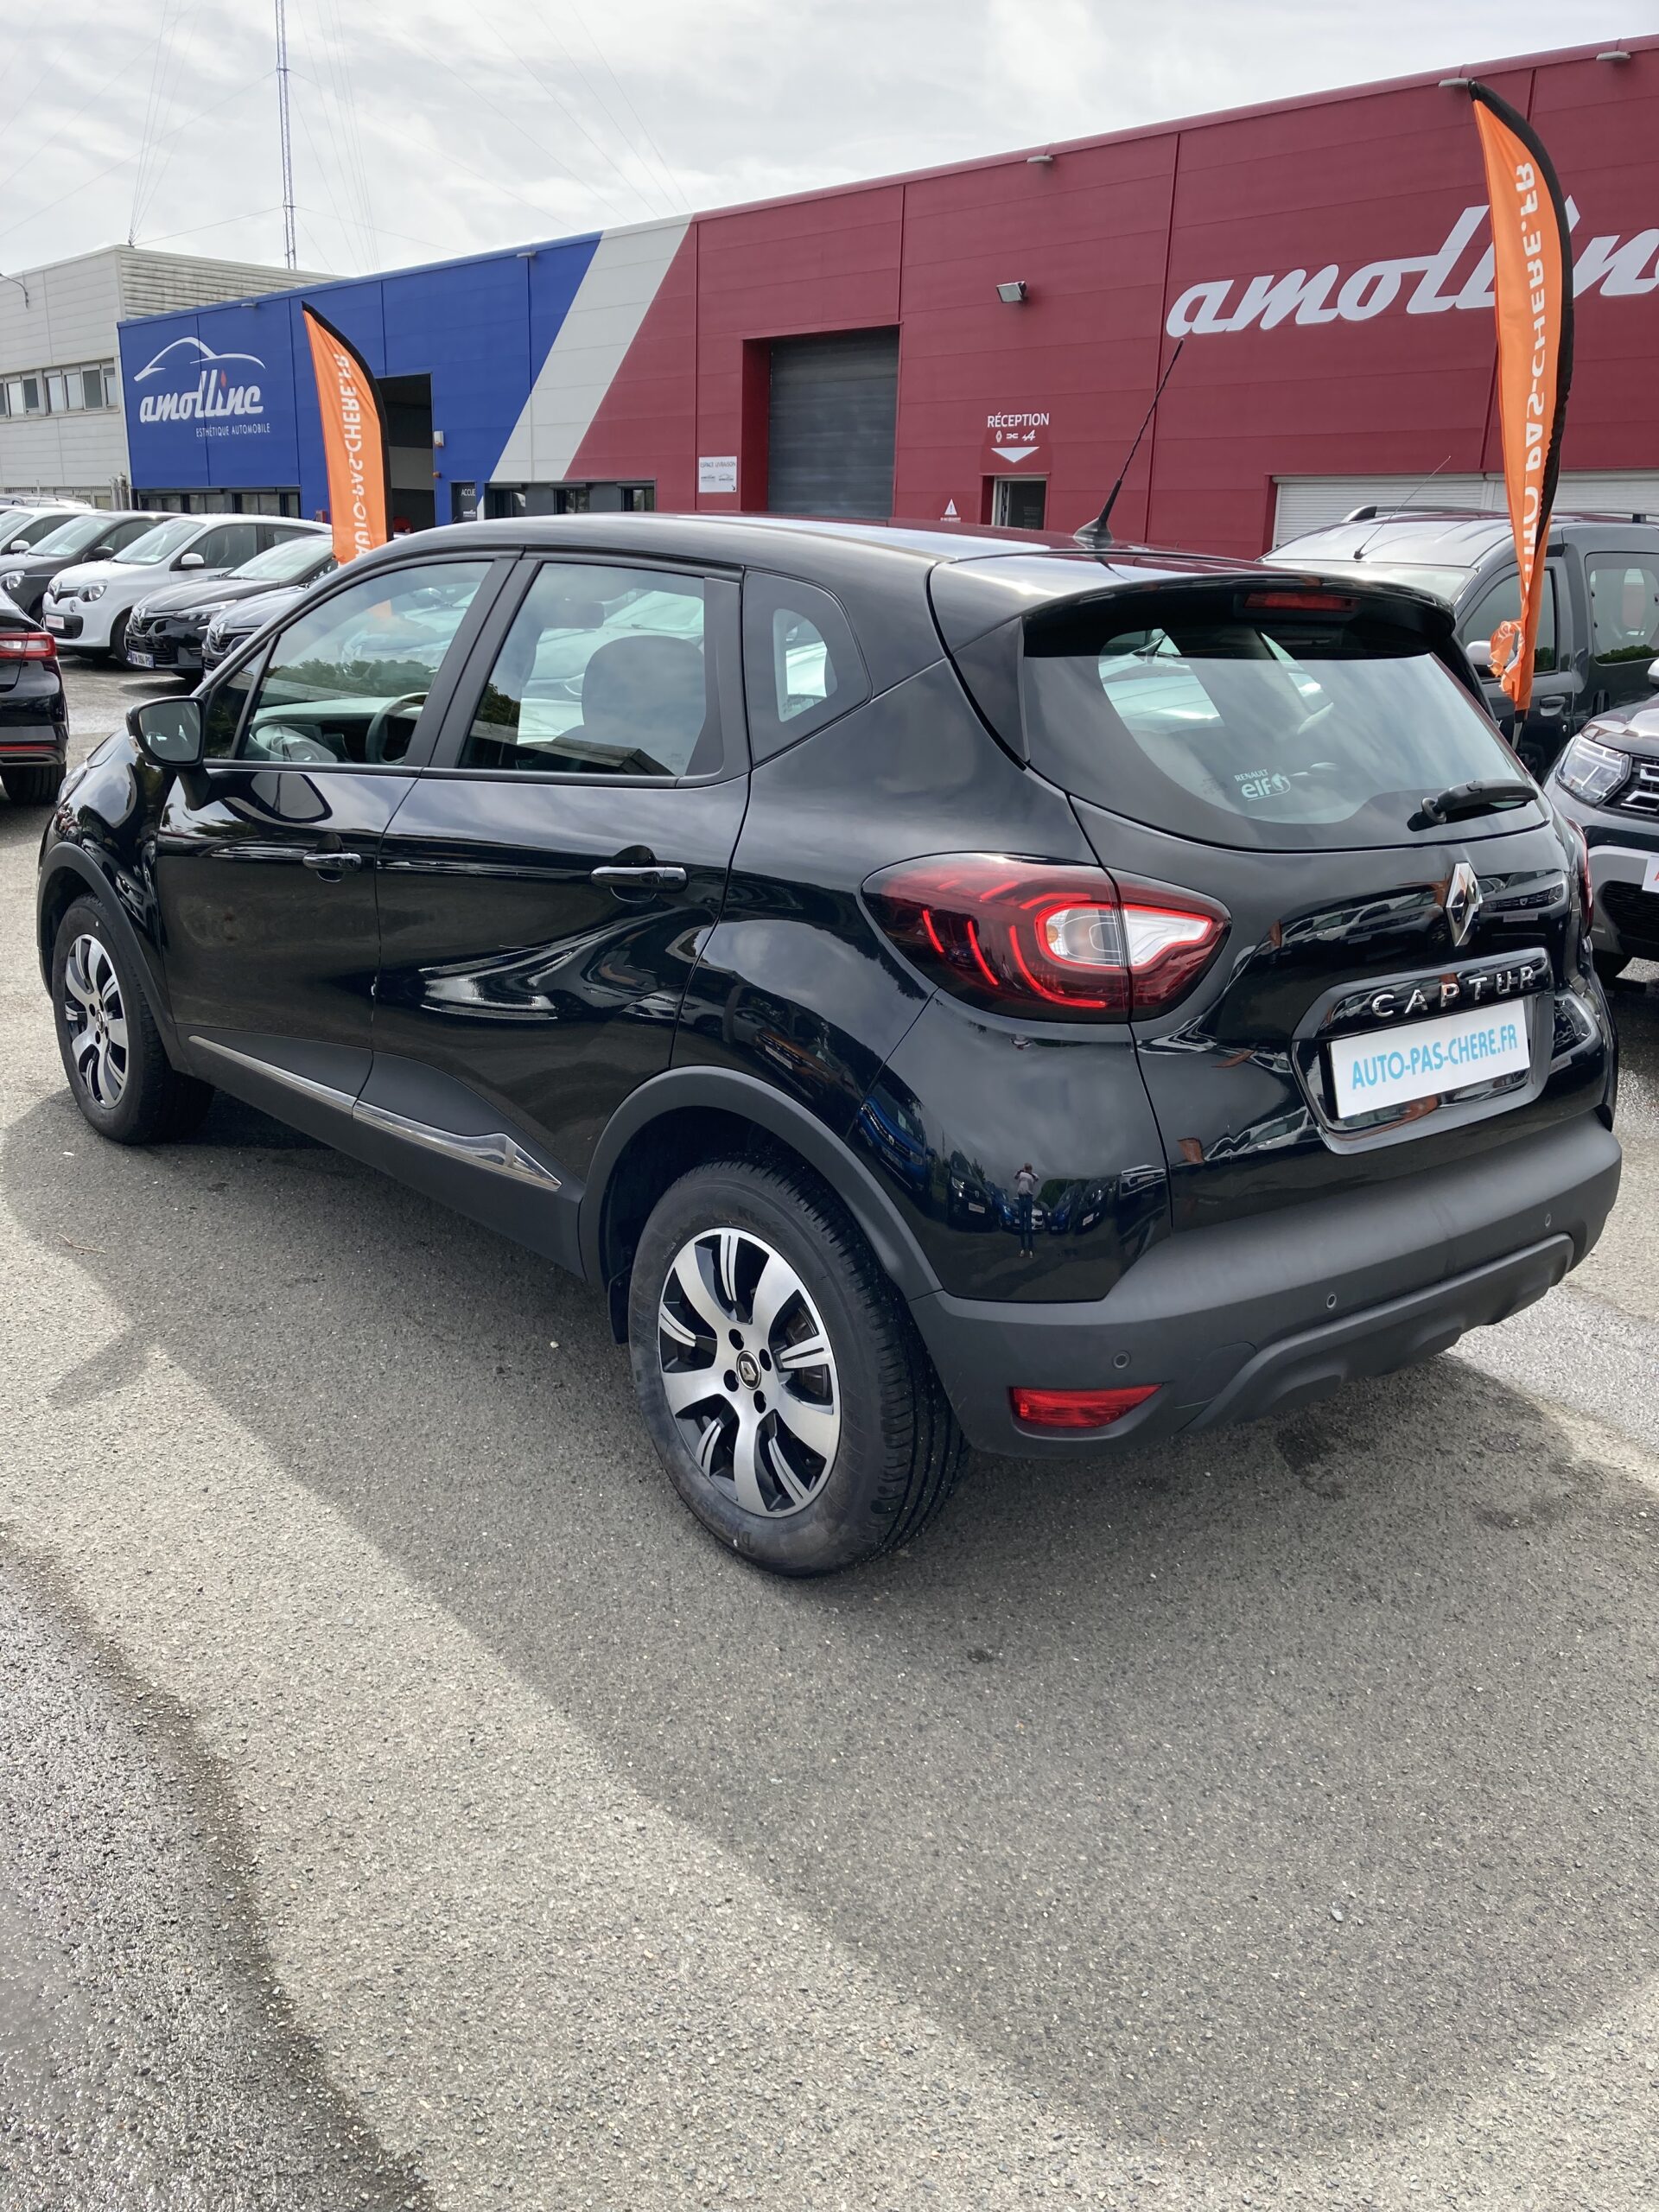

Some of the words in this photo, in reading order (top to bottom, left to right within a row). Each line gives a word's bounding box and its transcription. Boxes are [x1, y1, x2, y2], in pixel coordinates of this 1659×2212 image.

[987, 411, 1050, 428] RÉCEPTION
[195, 424, 230, 438] ESTHÉTIQUE
[232, 423, 270, 435] AUTOMOBILE
[1234, 768, 1268, 782] RENAULT
[1241, 778, 1272, 798] elf
[1371, 966, 1535, 1018] CAPTUR
[1351, 1024, 1517, 1090] AUTO-PAS-CHERE.FR
